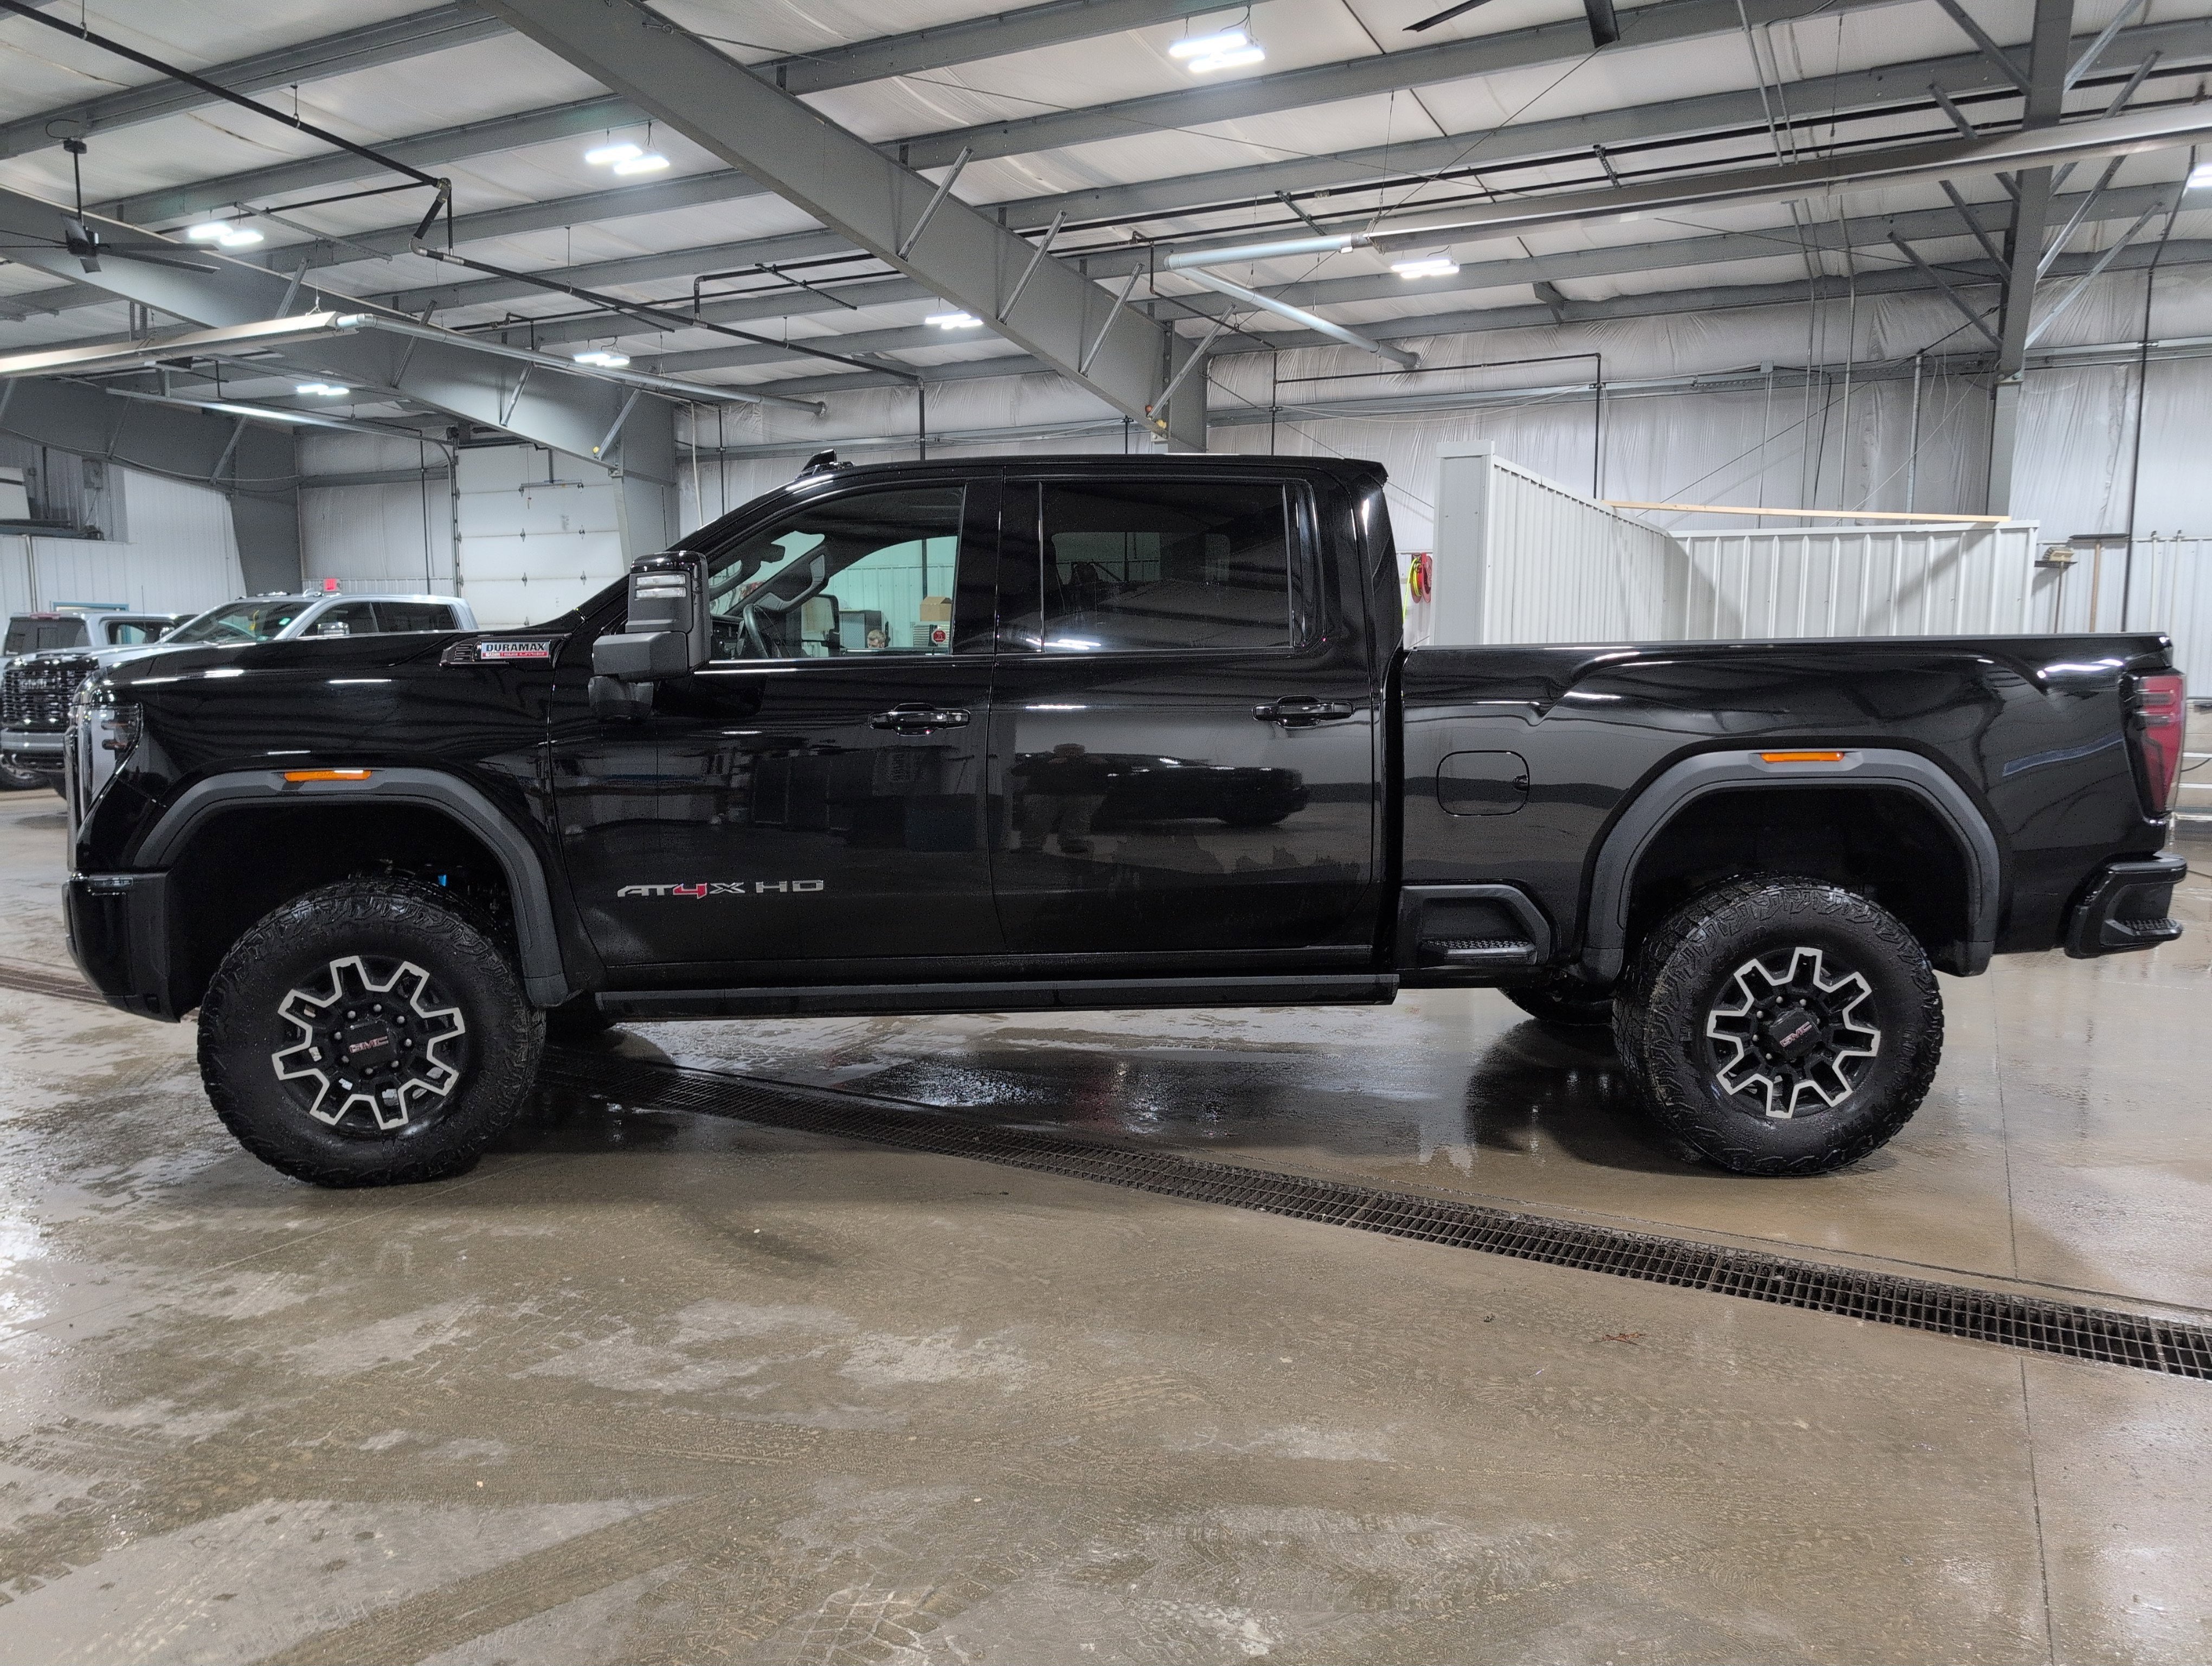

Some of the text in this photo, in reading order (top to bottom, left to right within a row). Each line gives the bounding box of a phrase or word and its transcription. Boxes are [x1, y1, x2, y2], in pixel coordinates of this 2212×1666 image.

[486, 643, 545, 651] DURAMAX
[617, 880, 824, 899] AT4X HD
[1780, 1021, 1812, 1047] GMC
[349, 1036, 389, 1053] GMC
